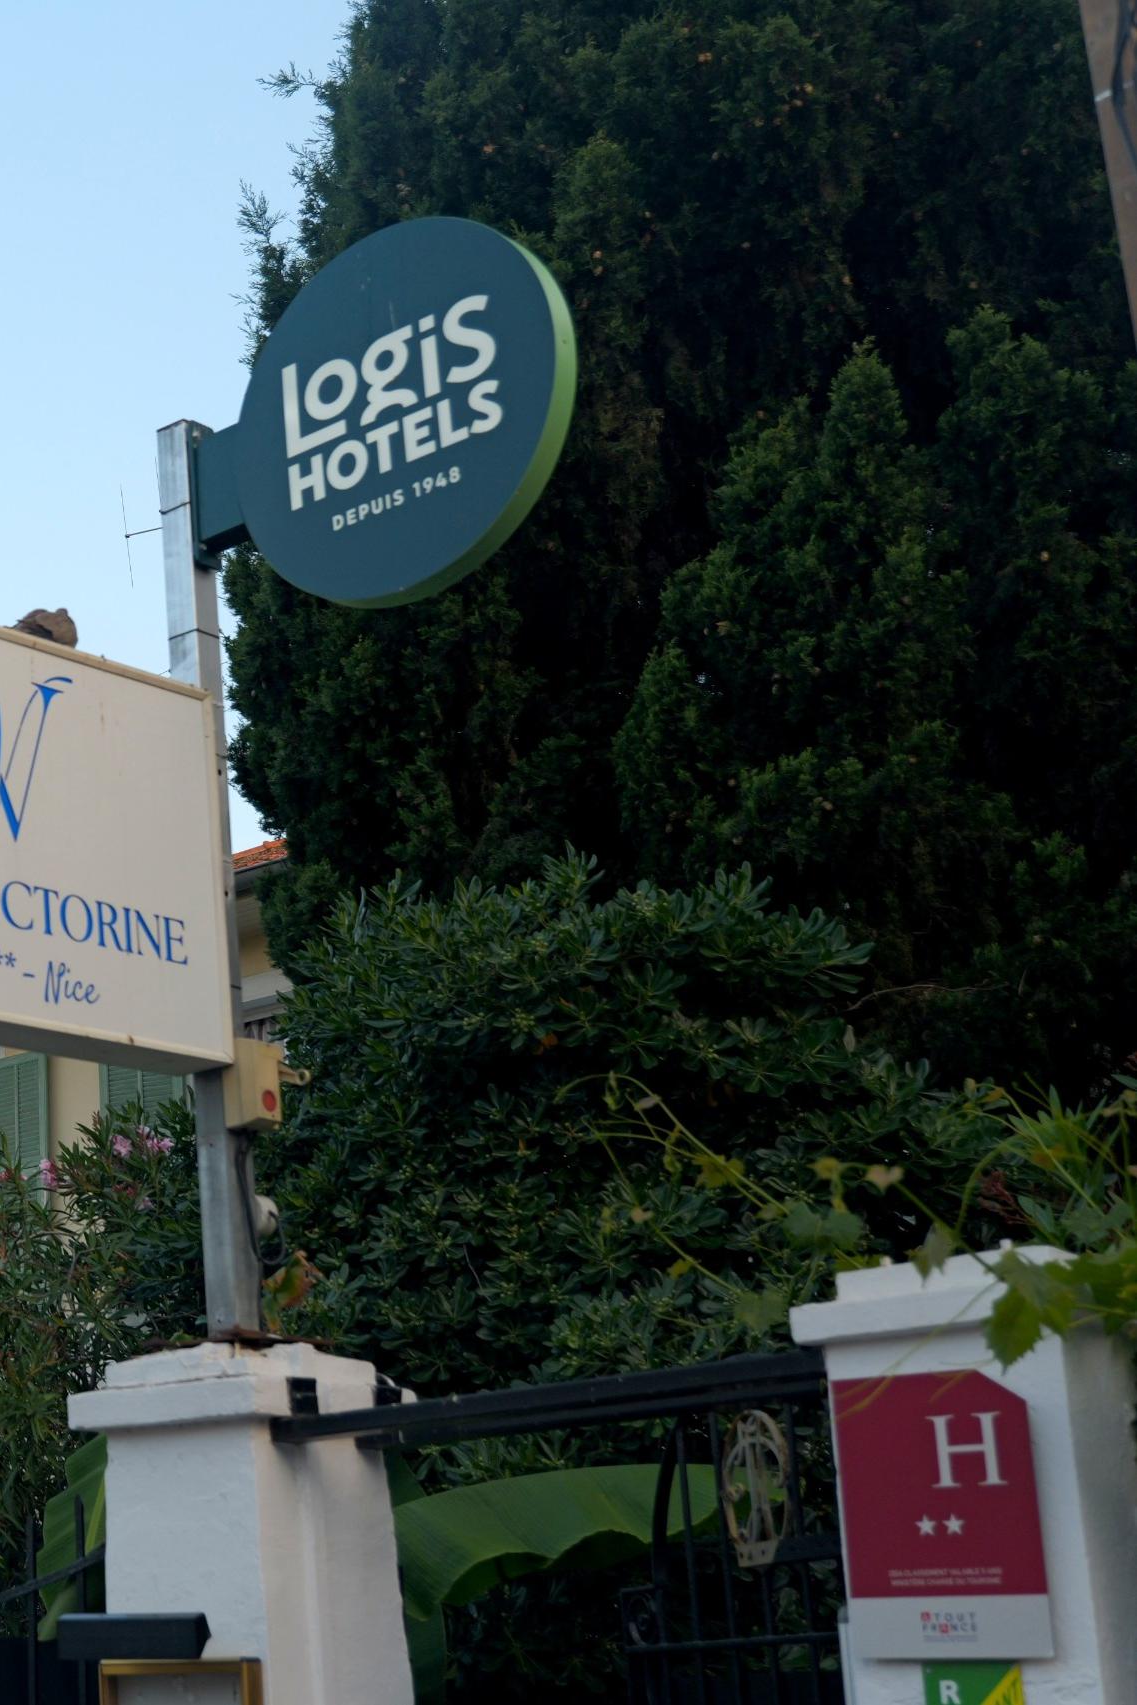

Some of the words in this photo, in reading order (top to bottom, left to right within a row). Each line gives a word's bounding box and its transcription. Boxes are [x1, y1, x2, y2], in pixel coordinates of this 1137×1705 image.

[287, 379, 503, 512] HOTELS
[331, 488, 405, 532] DEPUIS
[412, 465, 462, 498] 1948
[43, 959, 101, 1005] Nice
[924, 1410, 1009, 1489] H
